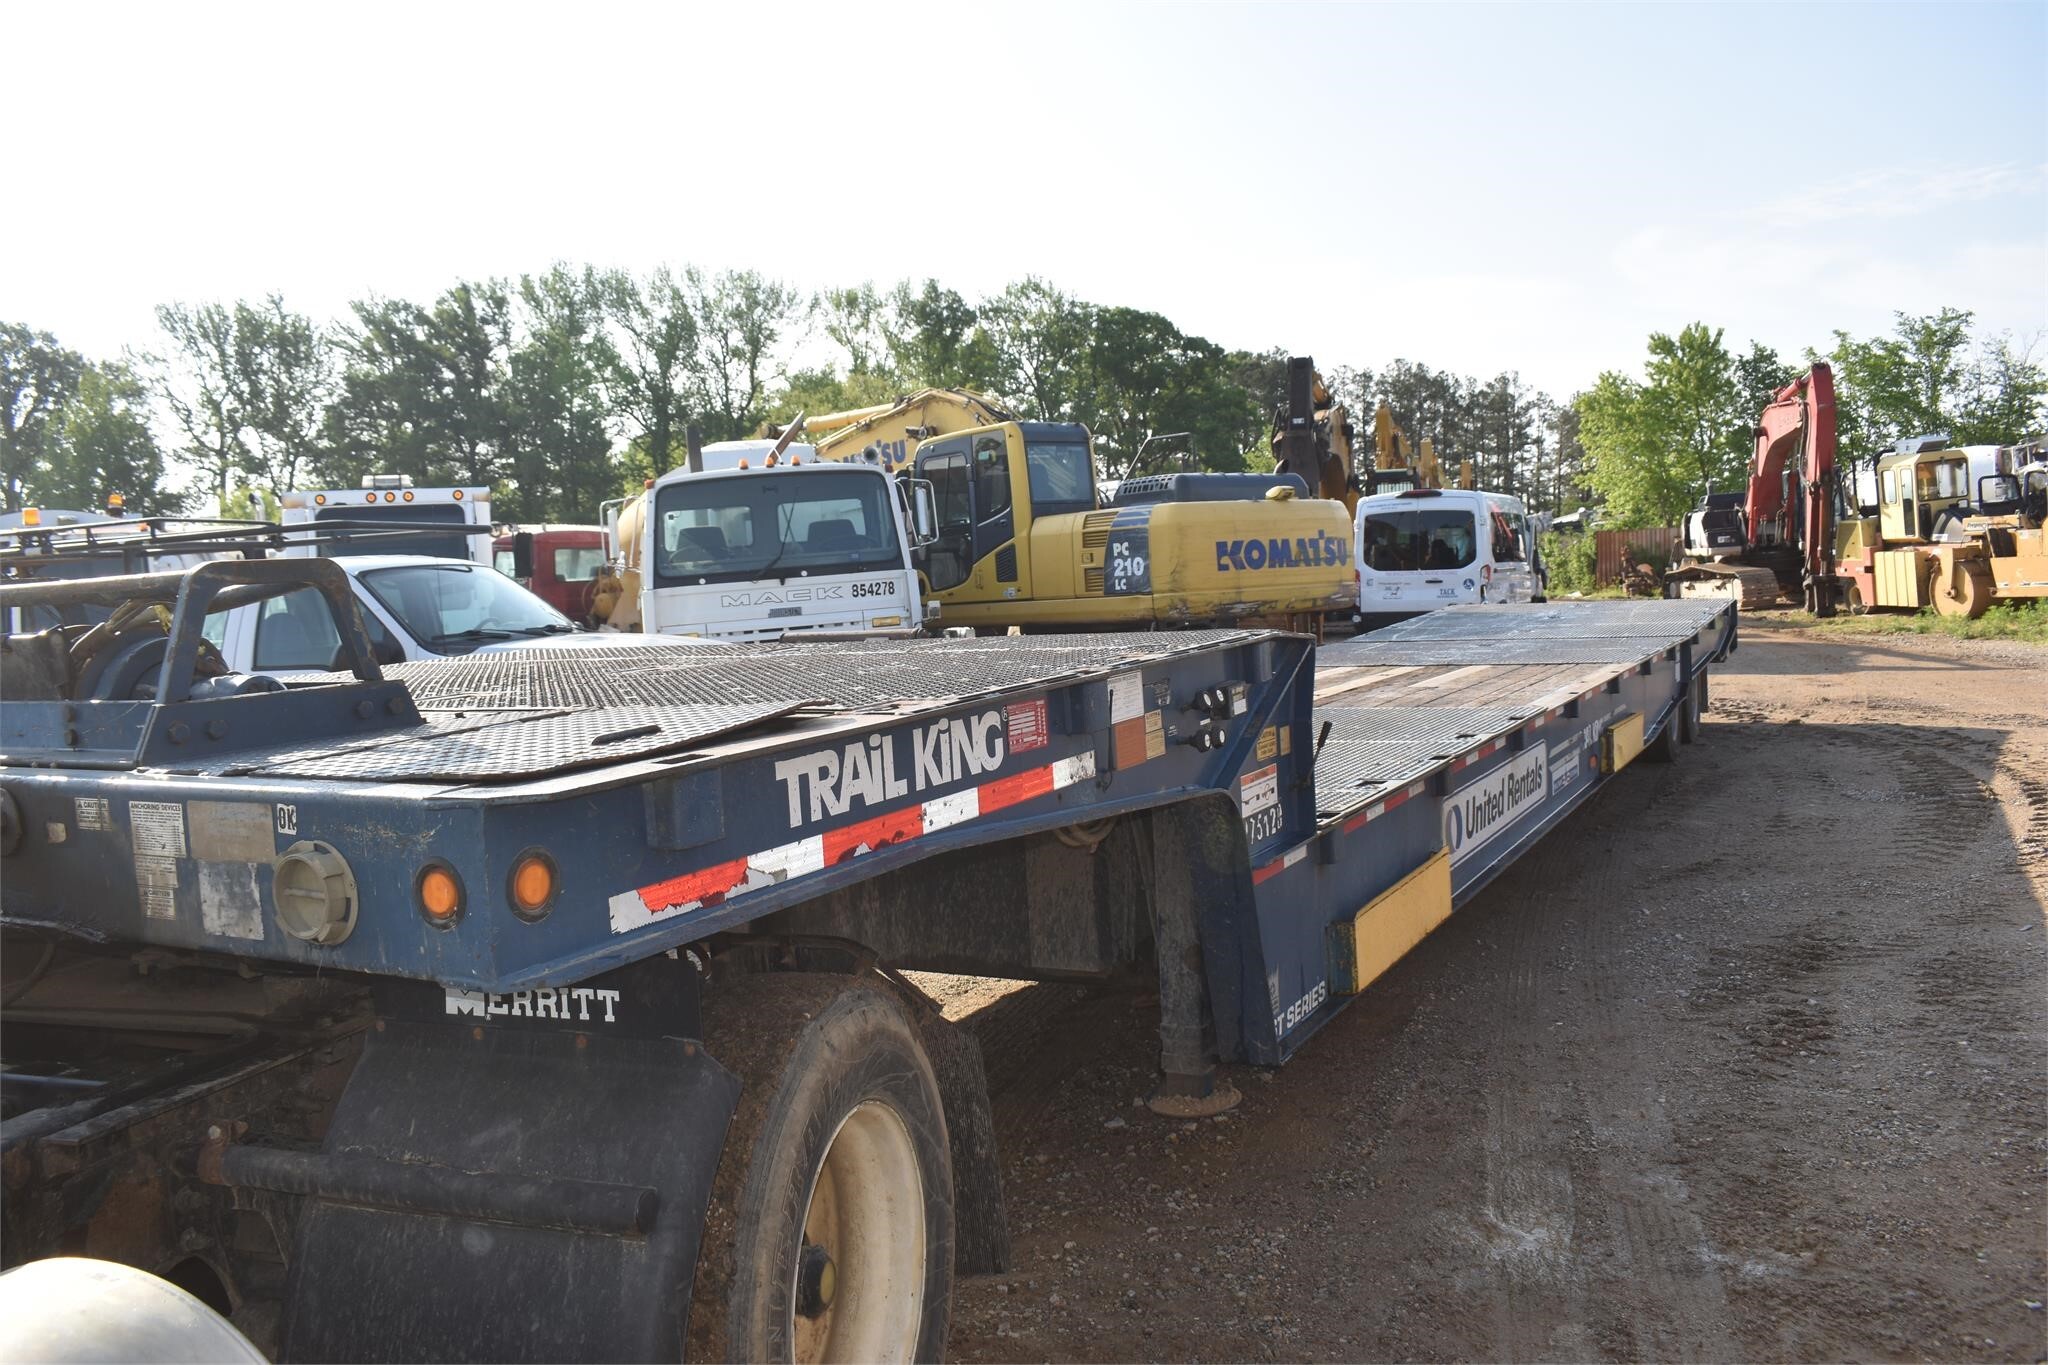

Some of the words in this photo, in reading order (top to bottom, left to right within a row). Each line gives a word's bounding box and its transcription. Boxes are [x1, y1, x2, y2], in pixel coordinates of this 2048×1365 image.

[1112, 542, 1129, 557] PC
[1216, 529, 1348, 572] KOMATSU
[1113, 556, 1145, 578] 210
[851, 580, 896, 598] 854278
[1114, 578, 1127, 591] LC
[720, 585, 844, 608] MACK
[130, 802, 159, 811] ANCHORING
[161, 804, 181, 812] DEVICES
[1465, 777, 1505, 840] United
[1507, 756, 1542, 811] Rentals
[278, 807, 296, 831] OK
[446, 986, 620, 1022] MERRITT
[1286, 980, 1326, 1029] SERIES
